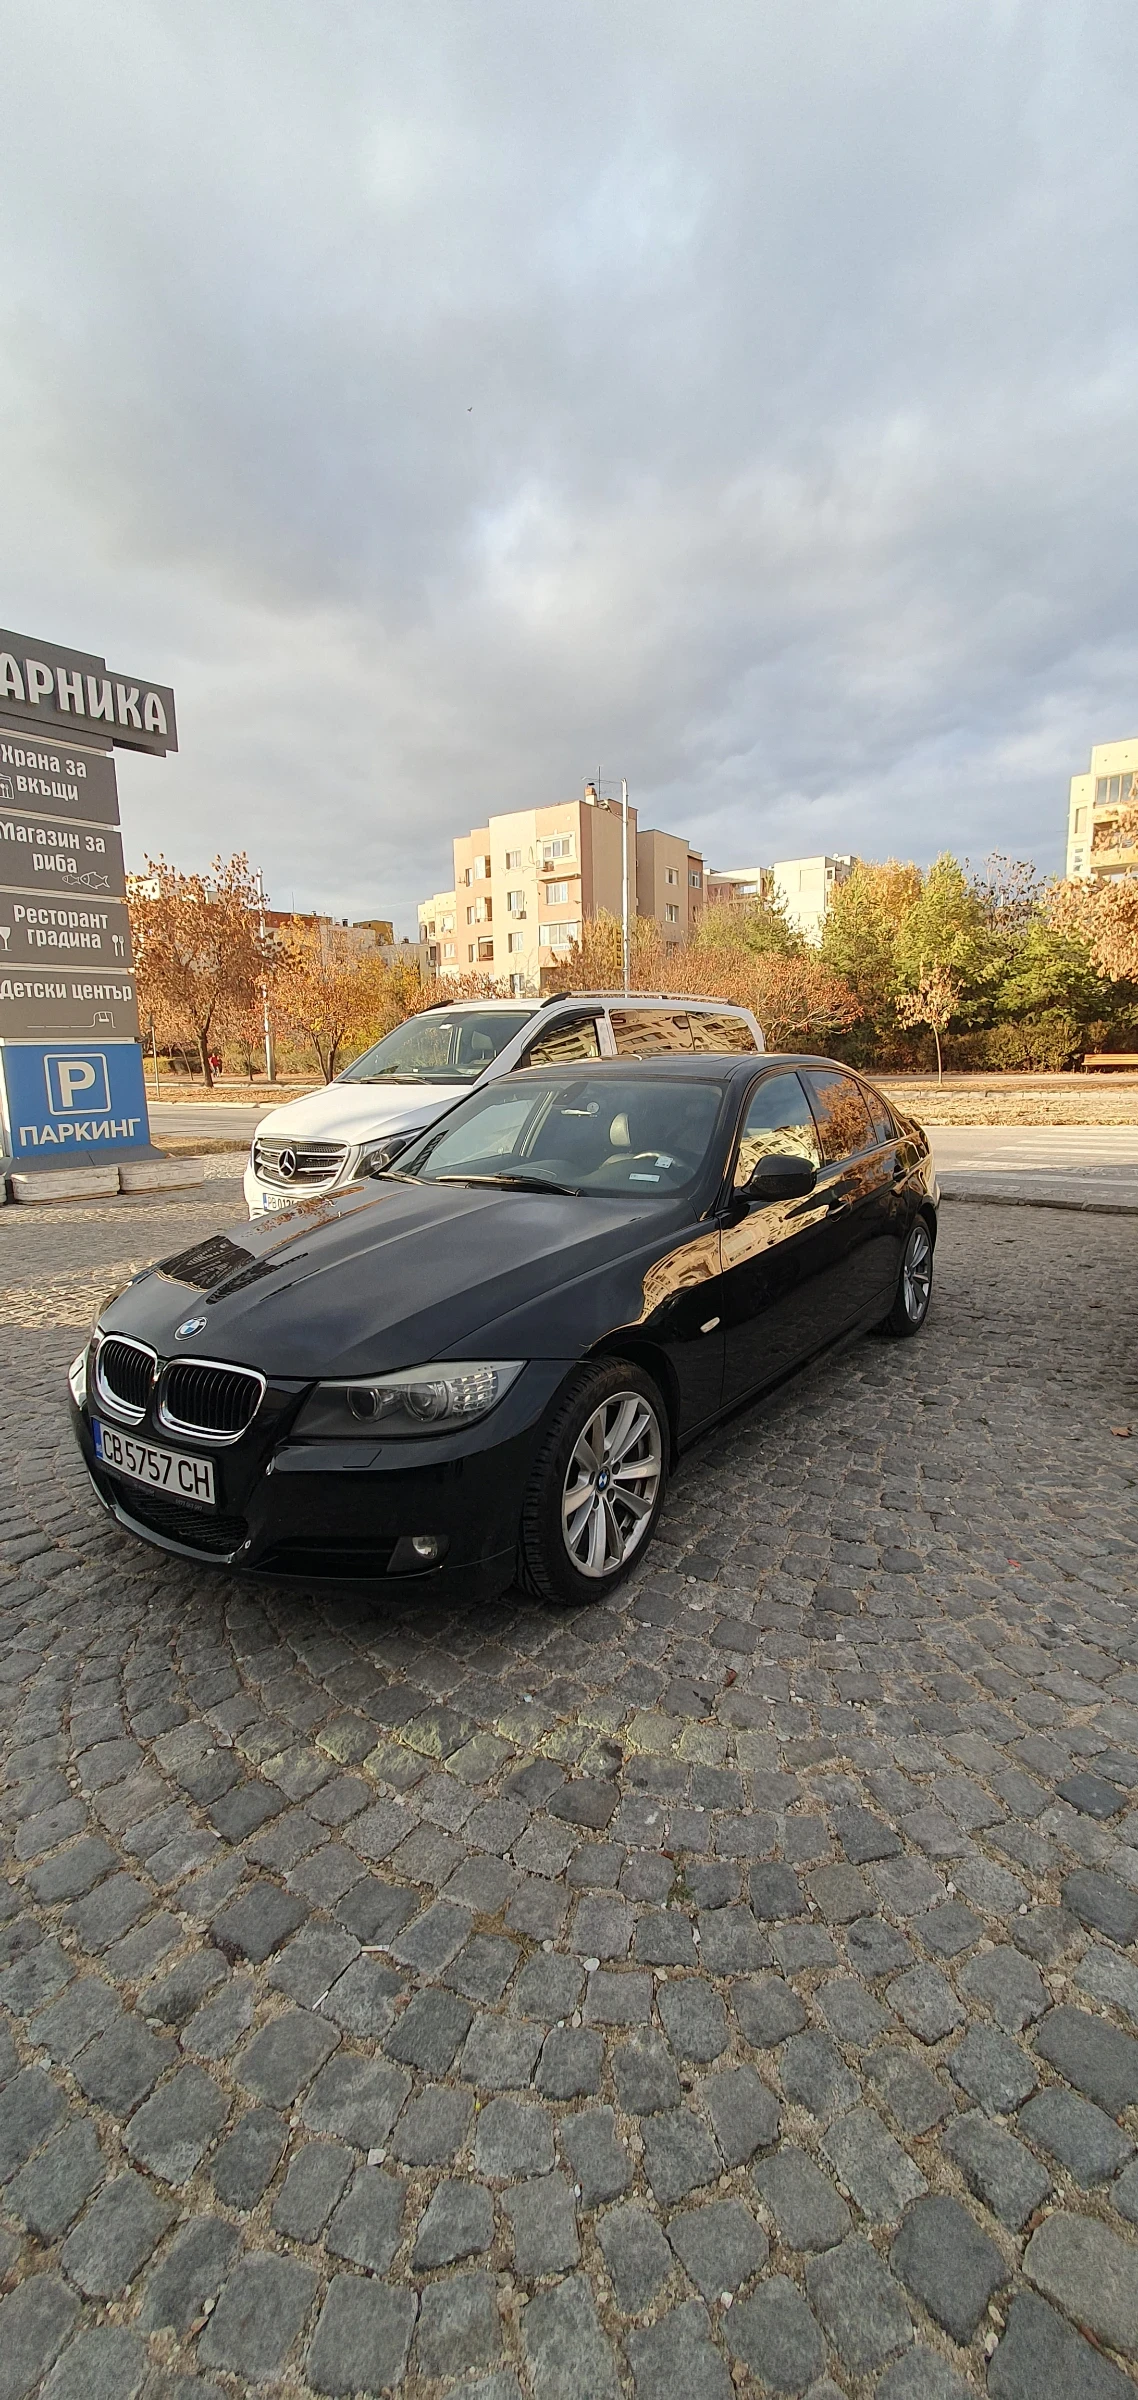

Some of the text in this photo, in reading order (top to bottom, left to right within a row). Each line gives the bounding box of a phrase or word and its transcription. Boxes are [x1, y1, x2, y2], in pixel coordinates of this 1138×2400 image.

[0, 652, 168, 735] АРНИКА
[1, 743, 87, 778] Храна за
[16, 775, 79, 801] вкъщи
[0, 821, 106, 853] Магазин за
[32, 853, 78, 874] риба
[13, 904, 108, 929] Ресторант
[27, 928, 102, 949] градина
[0, 979, 132, 1001] Детски център
[57, 1061, 96, 1108] P
[19, 1118, 141, 1147] ПАРКИНГ
[103, 1430, 123, 1465] CB
[125, 1440, 172, 1484] 5757
[178, 1460, 210, 1498] CH
